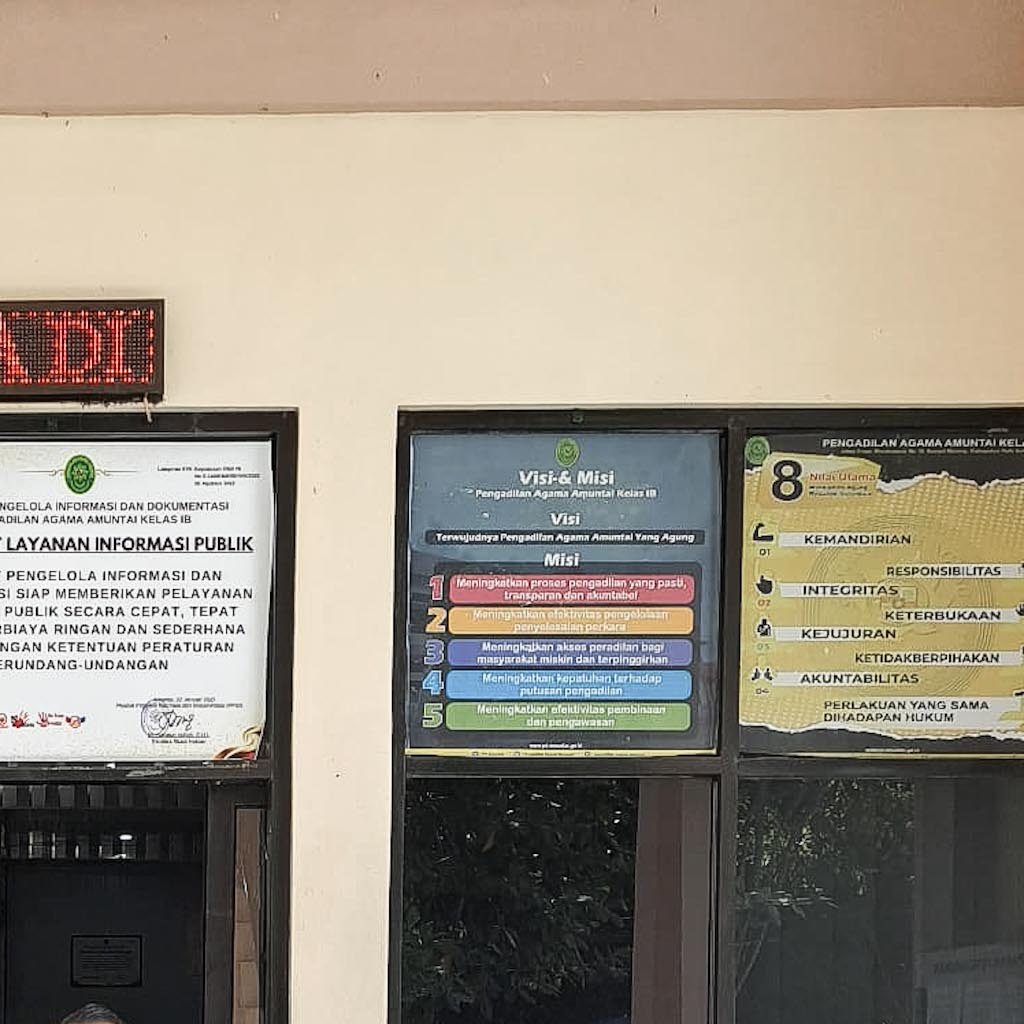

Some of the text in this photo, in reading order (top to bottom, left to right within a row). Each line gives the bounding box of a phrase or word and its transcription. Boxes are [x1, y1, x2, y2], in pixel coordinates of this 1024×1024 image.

[822, 439, 1024, 447] PENGADILAN AGAMA AMUNTAI KEL
[577, 471, 614, 485] Misi
[772, 460, 803, 501] 8
[55, 502, 117, 511] INFORMASI
[121, 502, 143, 511] DAN
[147, 502, 229, 511] DOKUMENTASI
[43, 515, 84, 524] AGAMA
[87, 515, 137, 524] AMUNTAI
[140, 515, 177, 524] KELAS
[181, 515, 192, 524] IB
[550, 513, 580, 525] Visi
[6, 537, 90, 551] LAYANAN
[95, 537, 190, 551] INFORMASI
[194, 537, 253, 551] PUBLIK
[804, 535, 911, 544] KEMANDIRIAN
[544, 553, 579, 567] Misi
[6, 571, 97, 581] PENGELOLA
[102, 571, 186, 581] INFORMASI
[192, 571, 222, 581] DAN
[887, 567, 1001, 576] RESPONSIBILITAS
[430, 575, 444, 600] 1
[803, 586, 898, 595] INTEGRITAS
[16, 588, 50, 599] SIAP
[55, 588, 156, 599] MEMBERIKAN
[162, 588, 253, 599] PELAYANAN
[5, 606, 58, 617] PUBLIK
[64, 606, 125, 617] SECARA
[131, 606, 184, 617] CEPAT,
[191, 606, 238, 617] TEPAT
[886, 611, 1001, 620] KETERBUKAAN
[426, 607, 447, 633] 2
[54, 624, 111, 635] RINGAN
[117, 624, 147, 635] DAN
[153, 624, 245, 635] SEDERHANA
[802, 629, 896, 638] KEJUJURAN
[48, 642, 137, 652] KETENTUAN
[142, 642, 233, 652] PERATURAN
[424, 639, 445, 665] 3
[855, 653, 999, 663] KETIDAKBERPIHAKAN
[422, 670, 444, 696] 4
[801, 674, 919, 684] AKUNTABILITAS
[824, 701, 989, 710] PERLAKUAN YANG SAMA
[422, 703, 443, 728] 5
[824, 713, 953, 722] DIHADAPAN HUKUM
